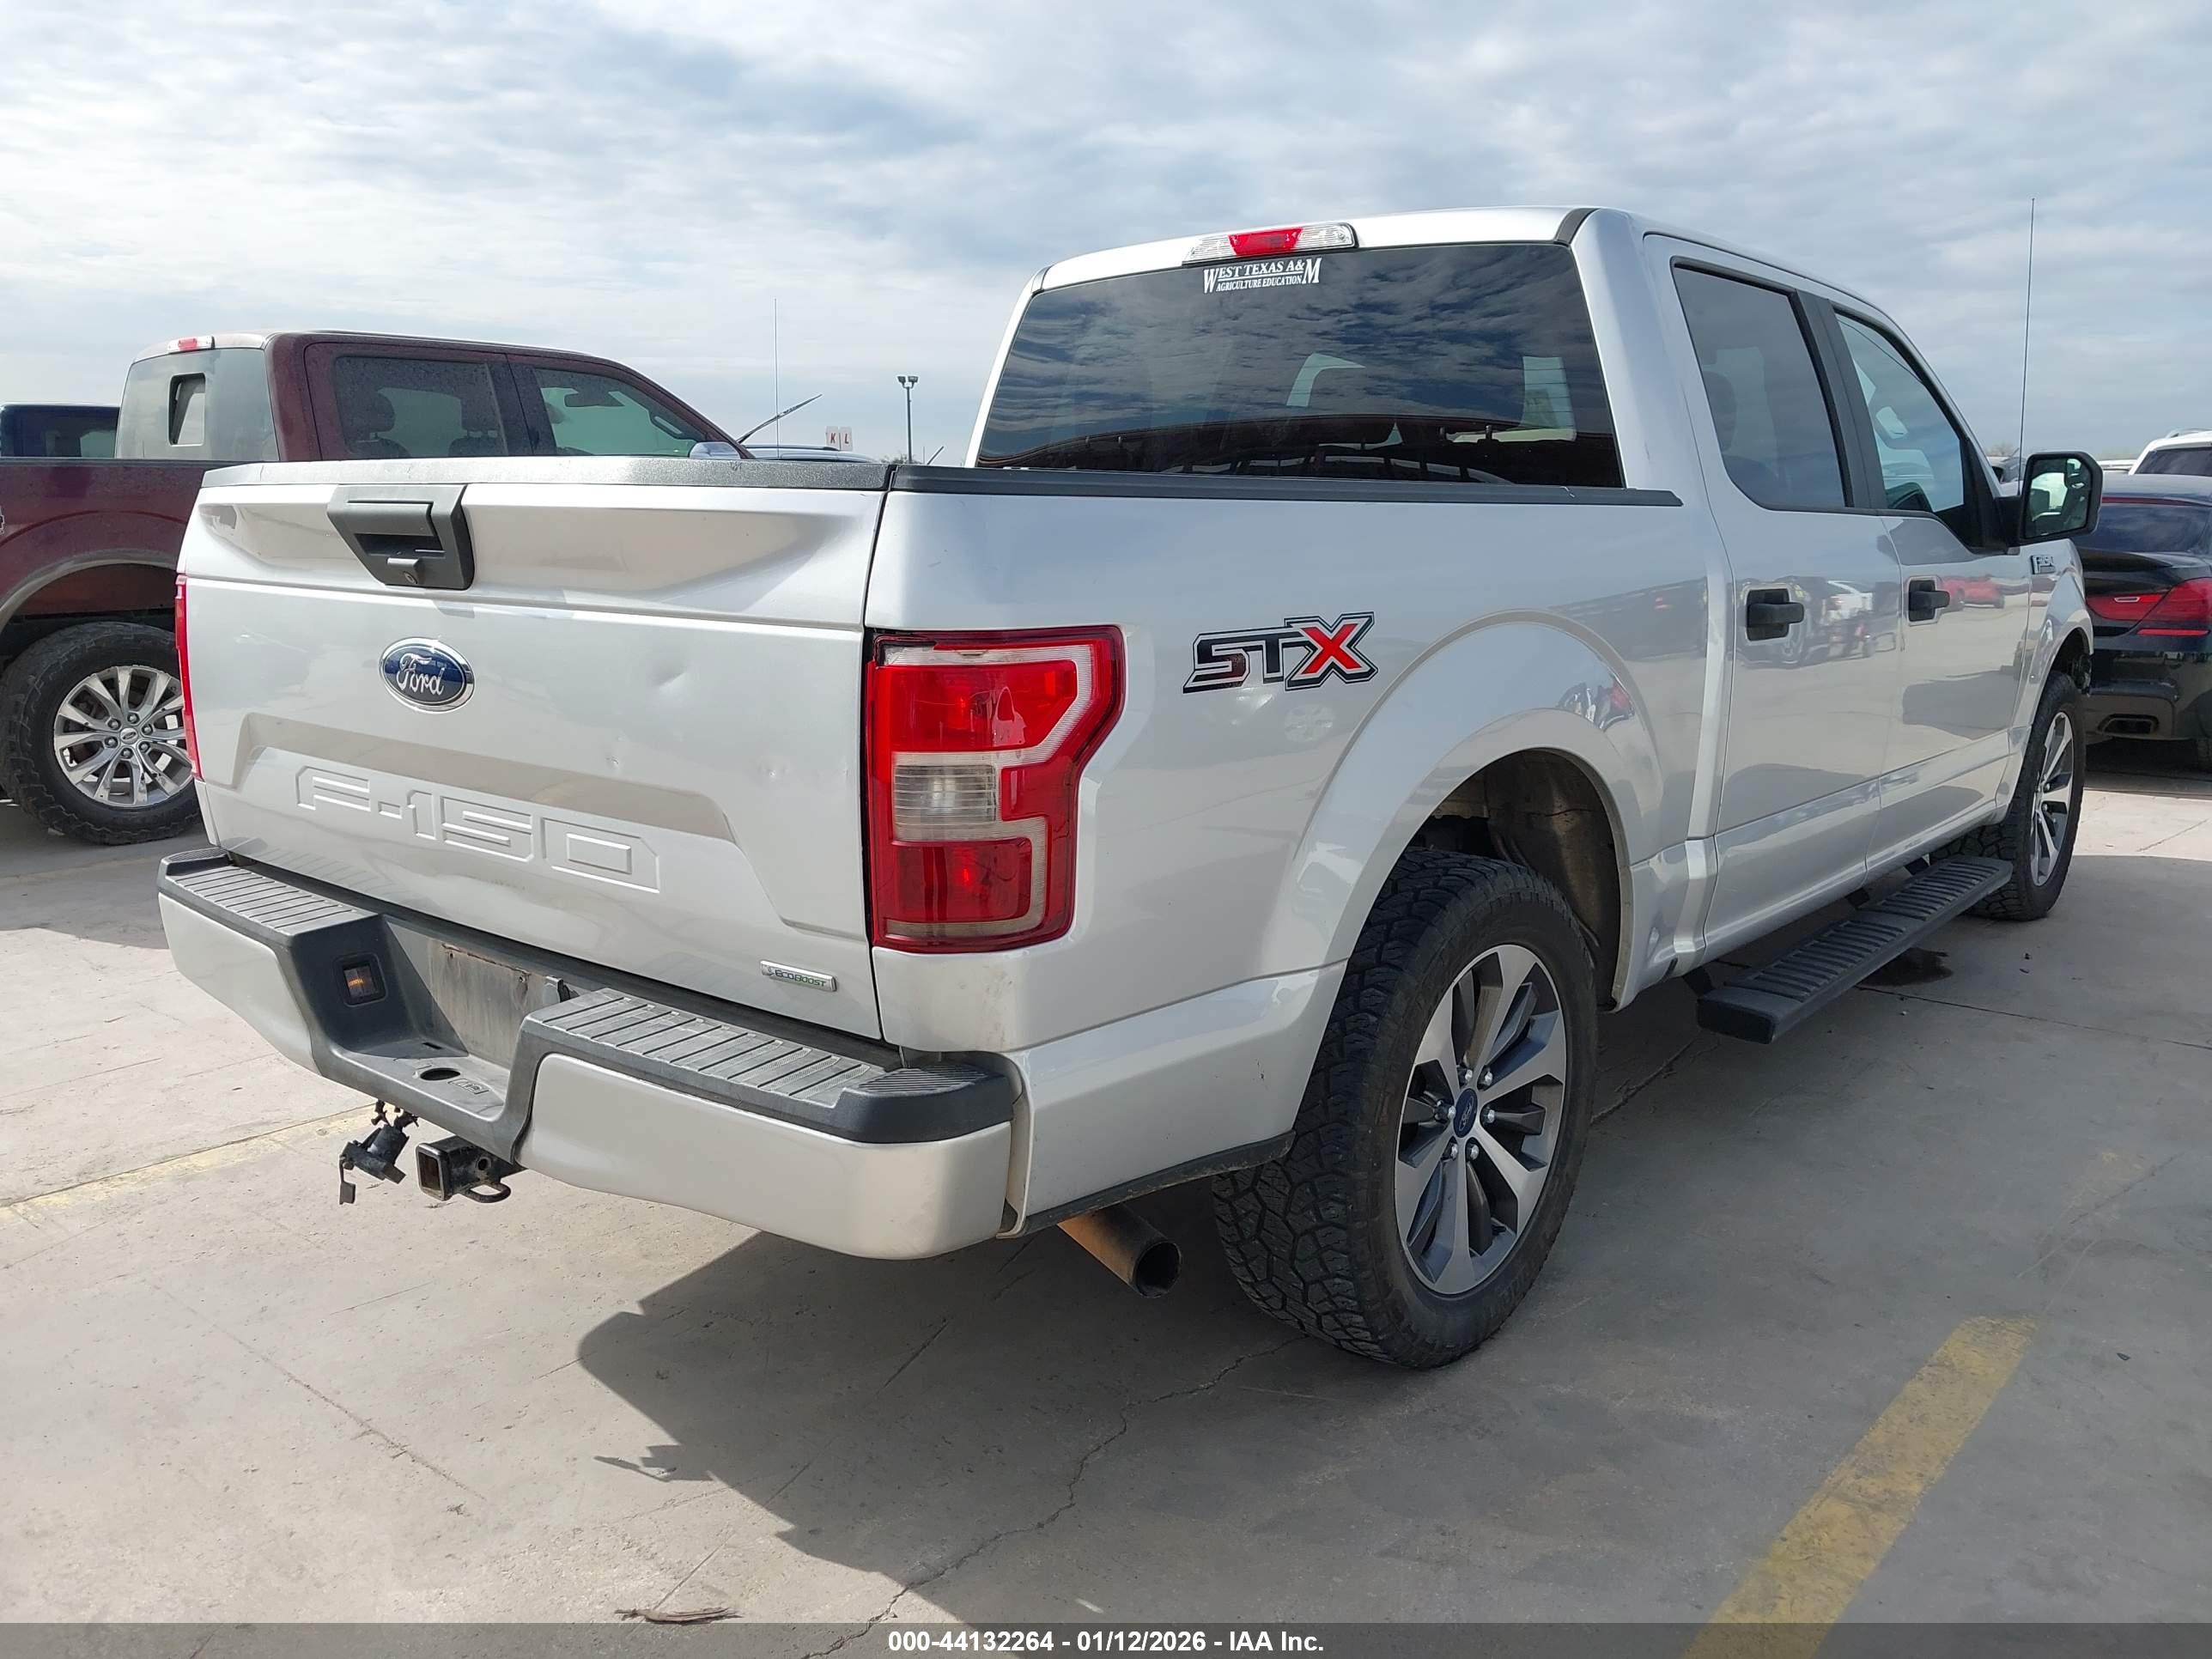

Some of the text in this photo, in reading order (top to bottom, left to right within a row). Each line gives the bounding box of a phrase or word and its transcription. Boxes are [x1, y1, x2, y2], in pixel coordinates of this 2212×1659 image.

[1203, 257, 1322, 294] WEST TEXAS A&M
[1216, 274, 1304, 292] AGRICULTURE EDUCATION
[396, 652, 447, 696] Ford
[1182, 611, 1379, 695] STX
[295, 765, 660, 895] F-150
